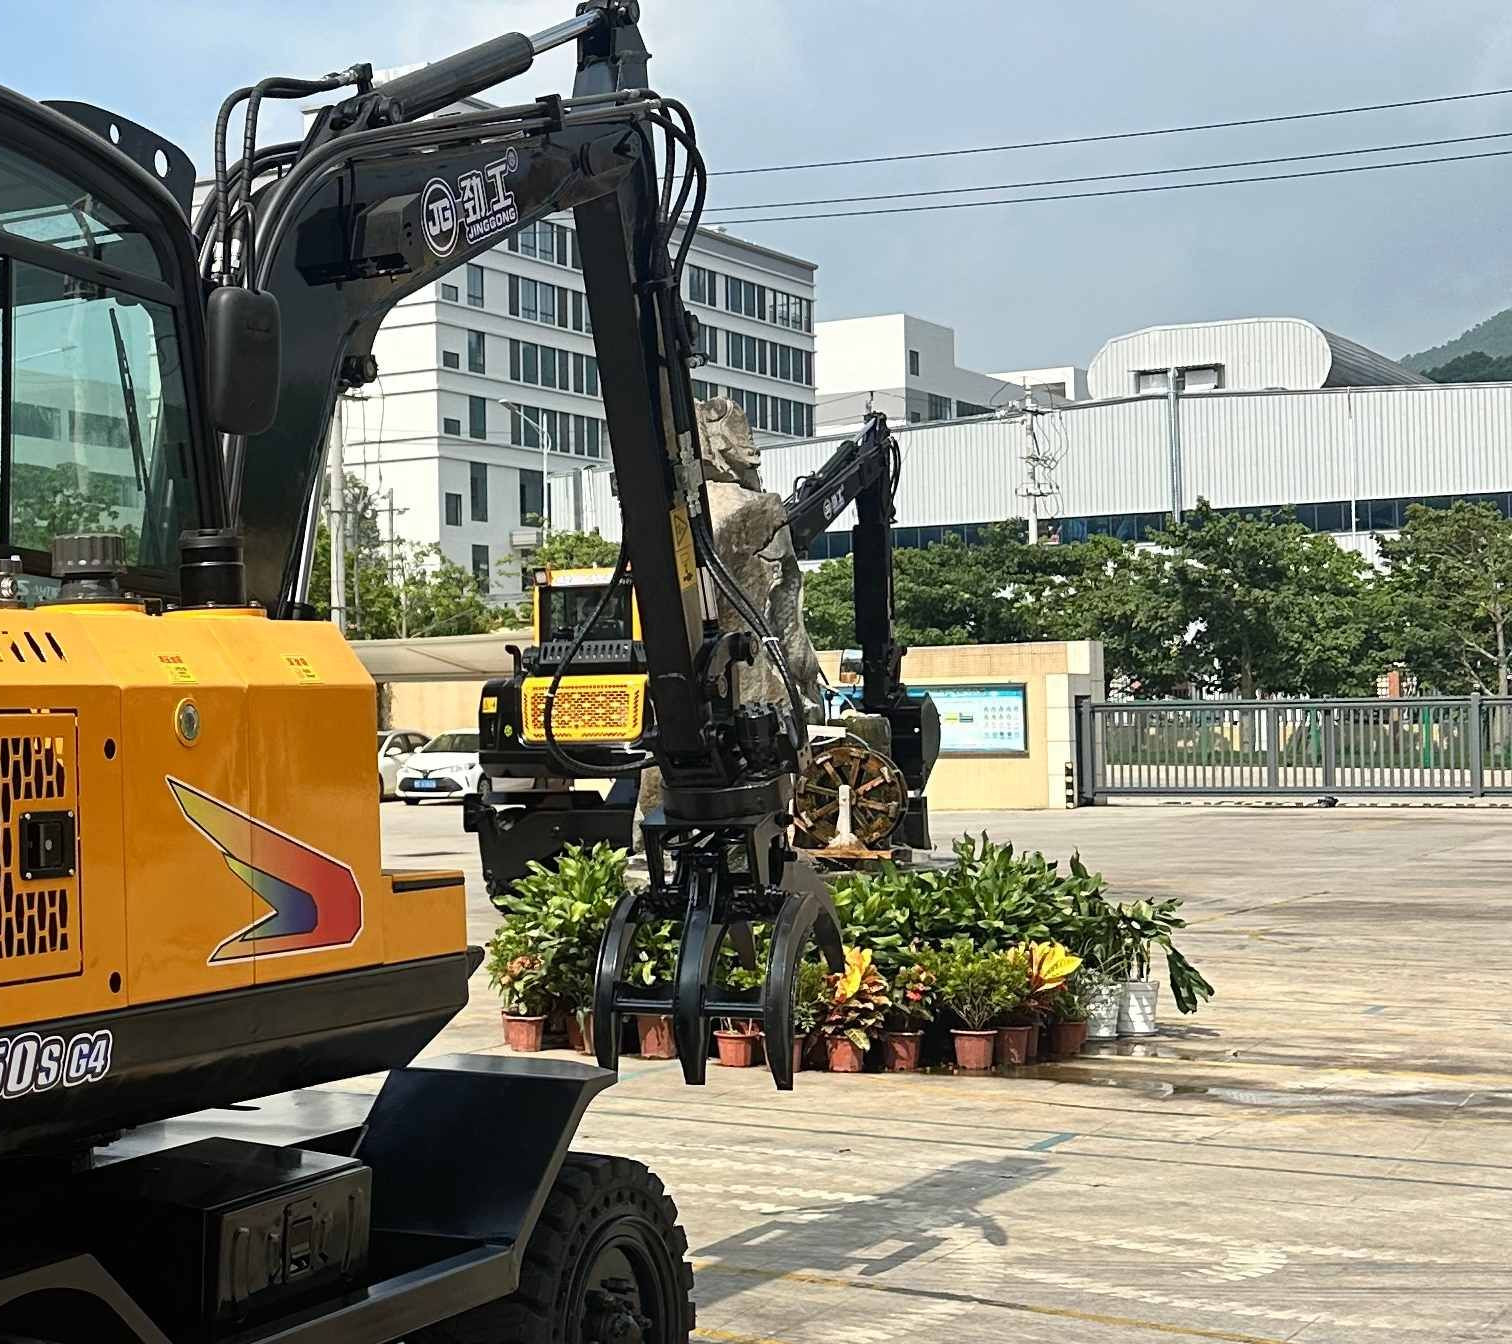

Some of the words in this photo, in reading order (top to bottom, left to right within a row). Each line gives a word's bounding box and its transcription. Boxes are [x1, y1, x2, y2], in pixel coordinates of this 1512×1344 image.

[459, 163, 515, 226] 劲工
[427, 197, 454, 237] JG
[467, 206, 518, 239] JINGGONG
